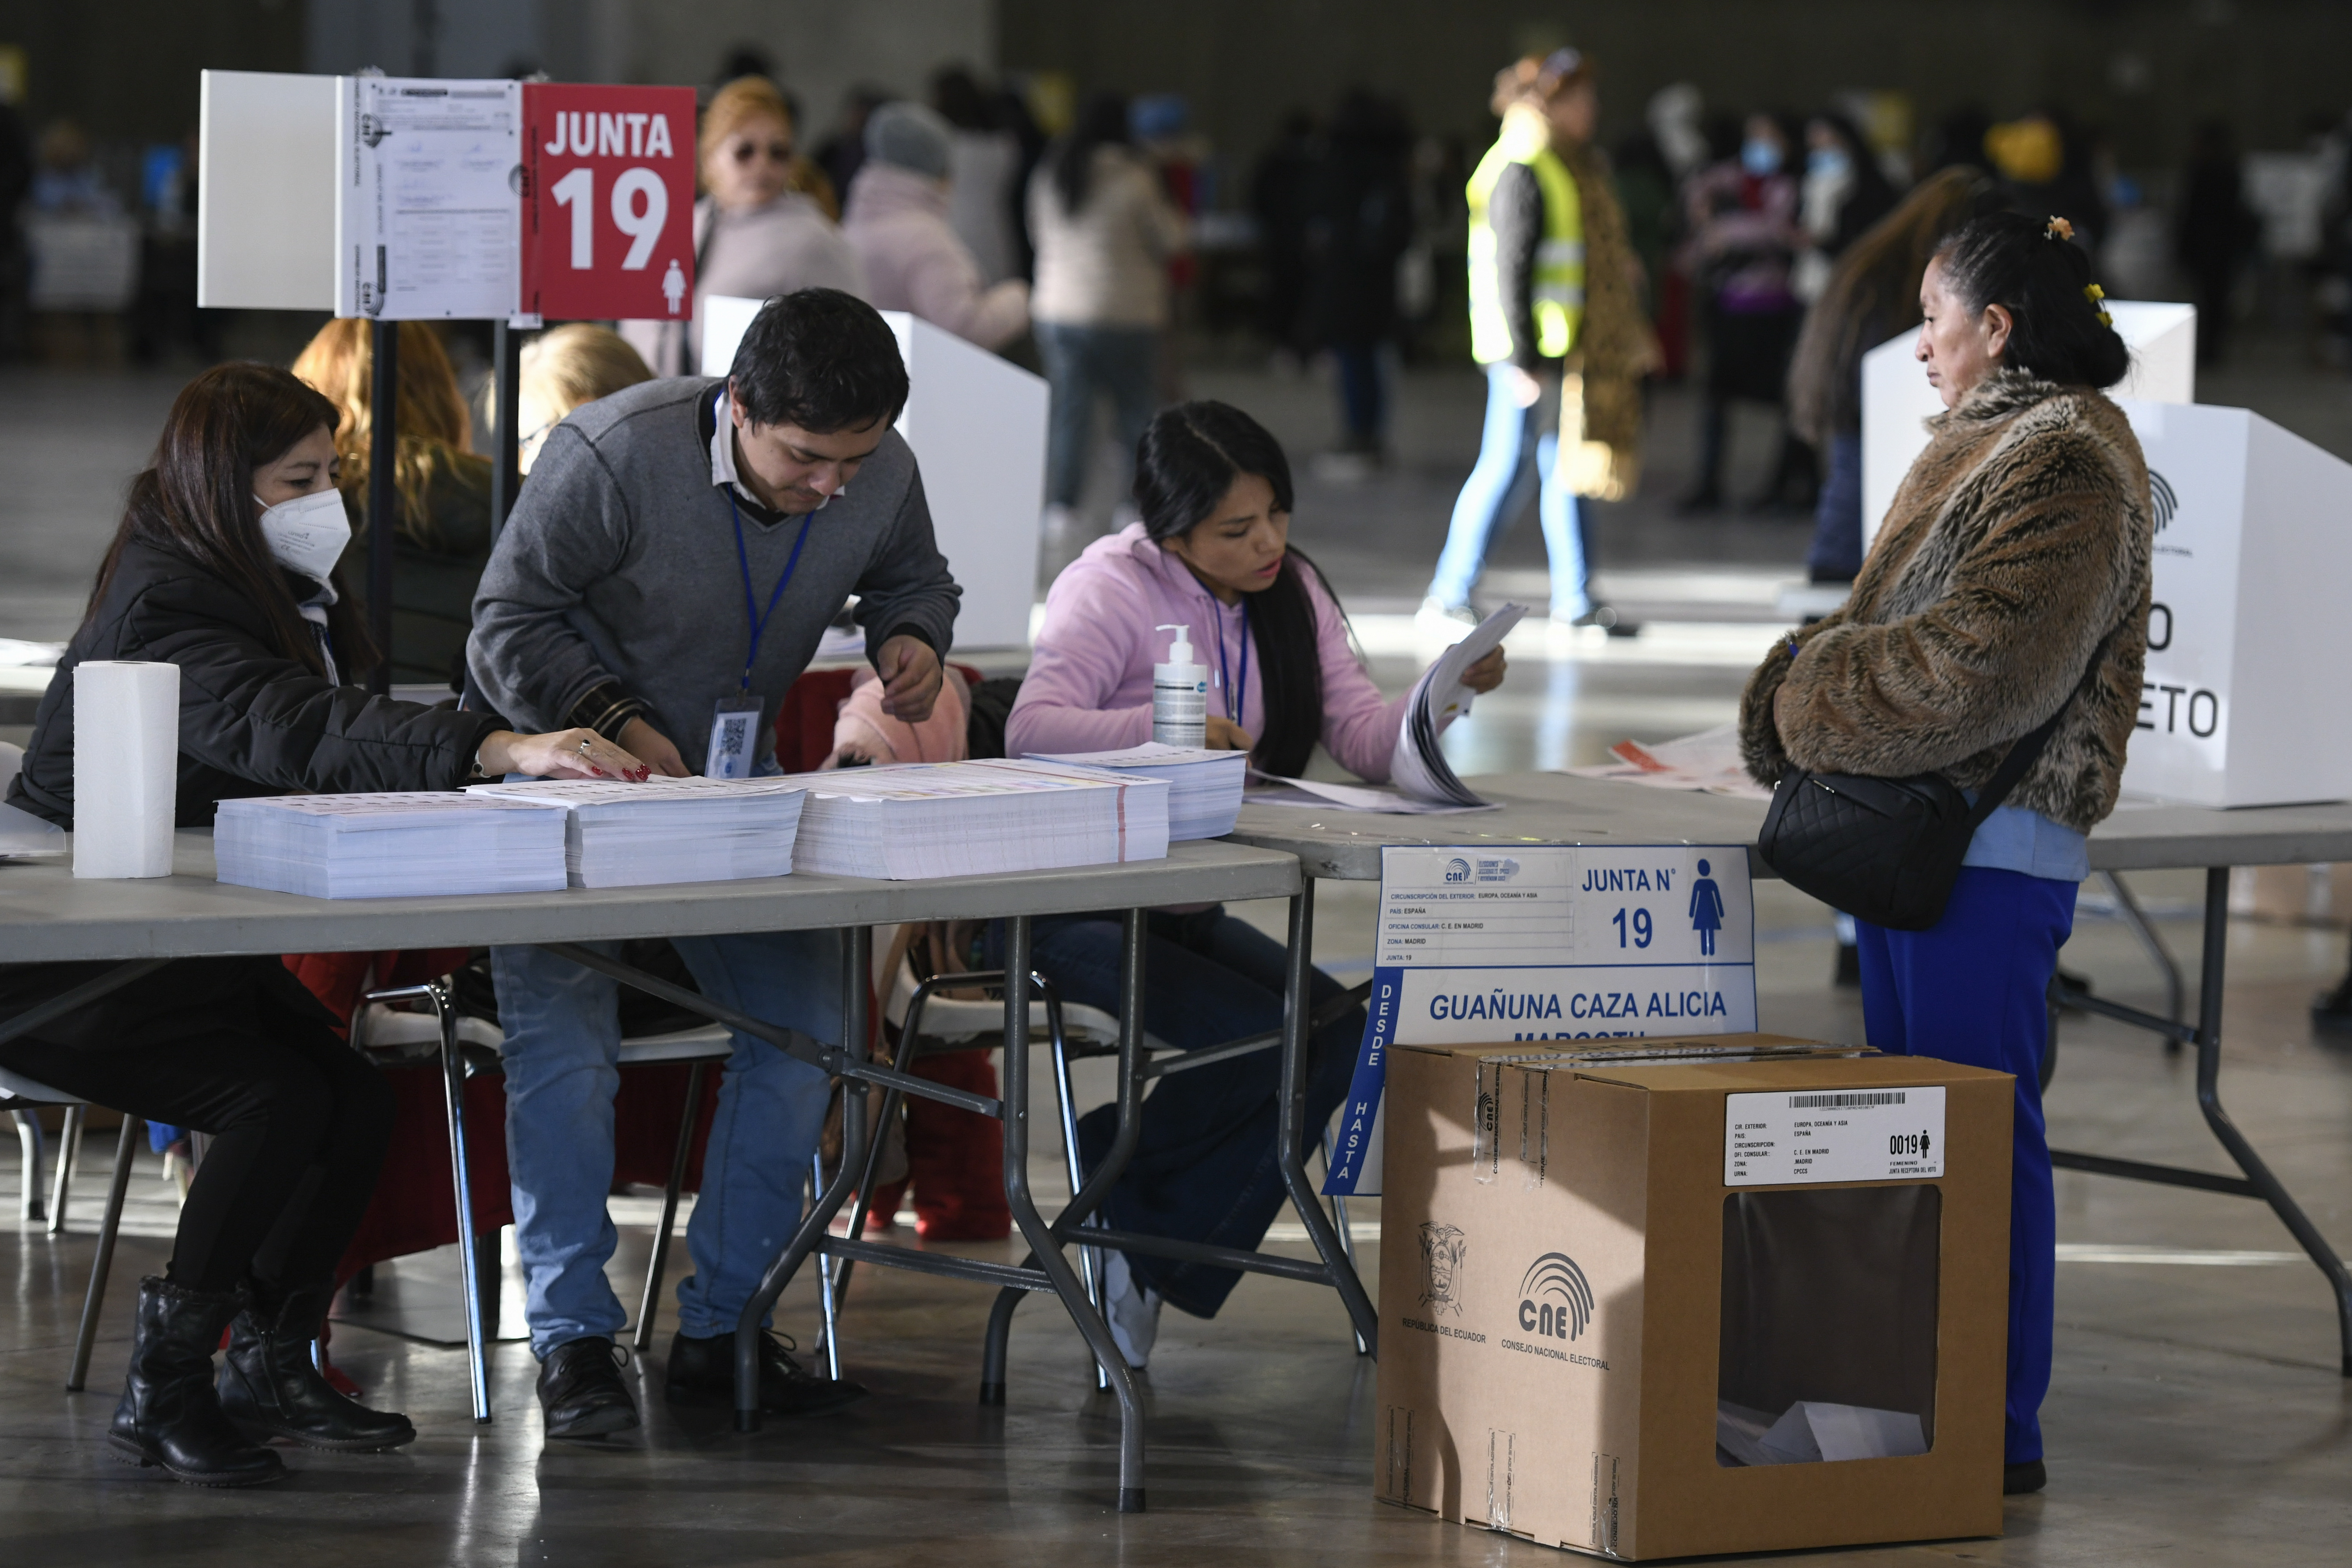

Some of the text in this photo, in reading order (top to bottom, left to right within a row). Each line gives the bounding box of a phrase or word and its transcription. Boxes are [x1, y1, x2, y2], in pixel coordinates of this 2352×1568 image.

[545, 111, 673, 158] JUNTA
[551, 167, 669, 270] 19
[1446, 872, 1463, 881] CNE
[1582, 869, 1651, 892] JUNTA
[1613, 907, 1652, 949] 19
[1430, 988, 1727, 1020] GUAÑUNA CAZA ALICIA
[1368, 985, 1392, 1066] DESDE
[1337, 1102, 1367, 1179] HASTA
[1890, 1134, 1917, 1155] 0019
[1402, 1317, 1486, 1344] REPÚBLICA DEL ECUADOR
[1519, 1299, 1567, 1340] CNE
[1501, 1339, 1610, 1371] CONSEJO NACIONAL ELECTORAL
